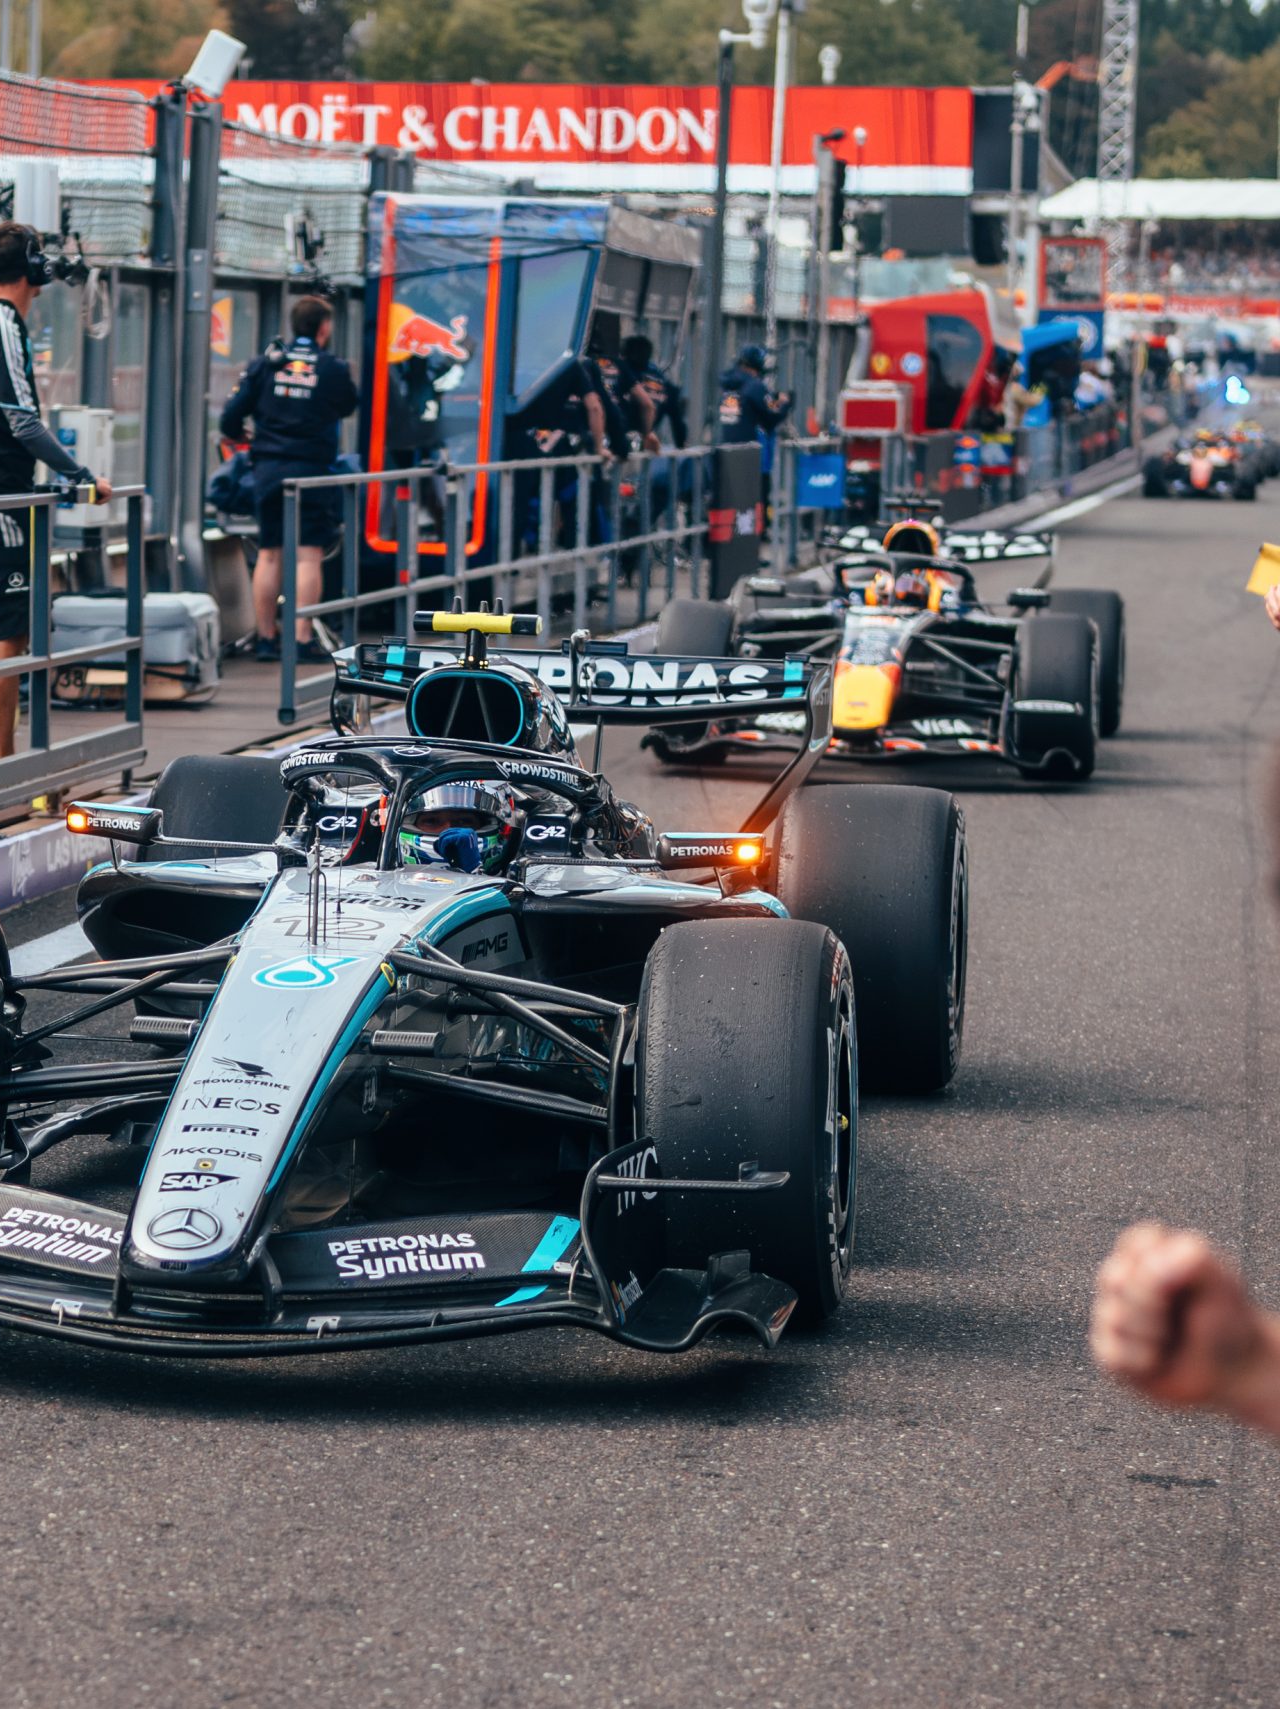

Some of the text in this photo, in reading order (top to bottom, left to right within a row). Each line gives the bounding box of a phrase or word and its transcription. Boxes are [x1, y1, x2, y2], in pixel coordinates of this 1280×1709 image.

[235, 94, 720, 155] MOËT & CHANDON
[502, 761, 580, 788] CROWDSTRIKE
[86, 816, 141, 831] PETRONAS
[670, 845, 735, 857] PETRONAS
[273, 915, 386, 941] 12
[474, 931, 509, 960] AMG
[193, 1077, 291, 1092] CROWDSTRIKE
[182, 1097, 282, 1115] INEOS
[181, 1123, 260, 1138] PIRELLI
[160, 1173, 222, 1191] SAP
[617, 1146, 659, 1217] IWC
[2, 1206, 124, 1245] PETRONAS
[328, 1232, 477, 1257] PETRONAS
[335, 1249, 486, 1280] Syntium
